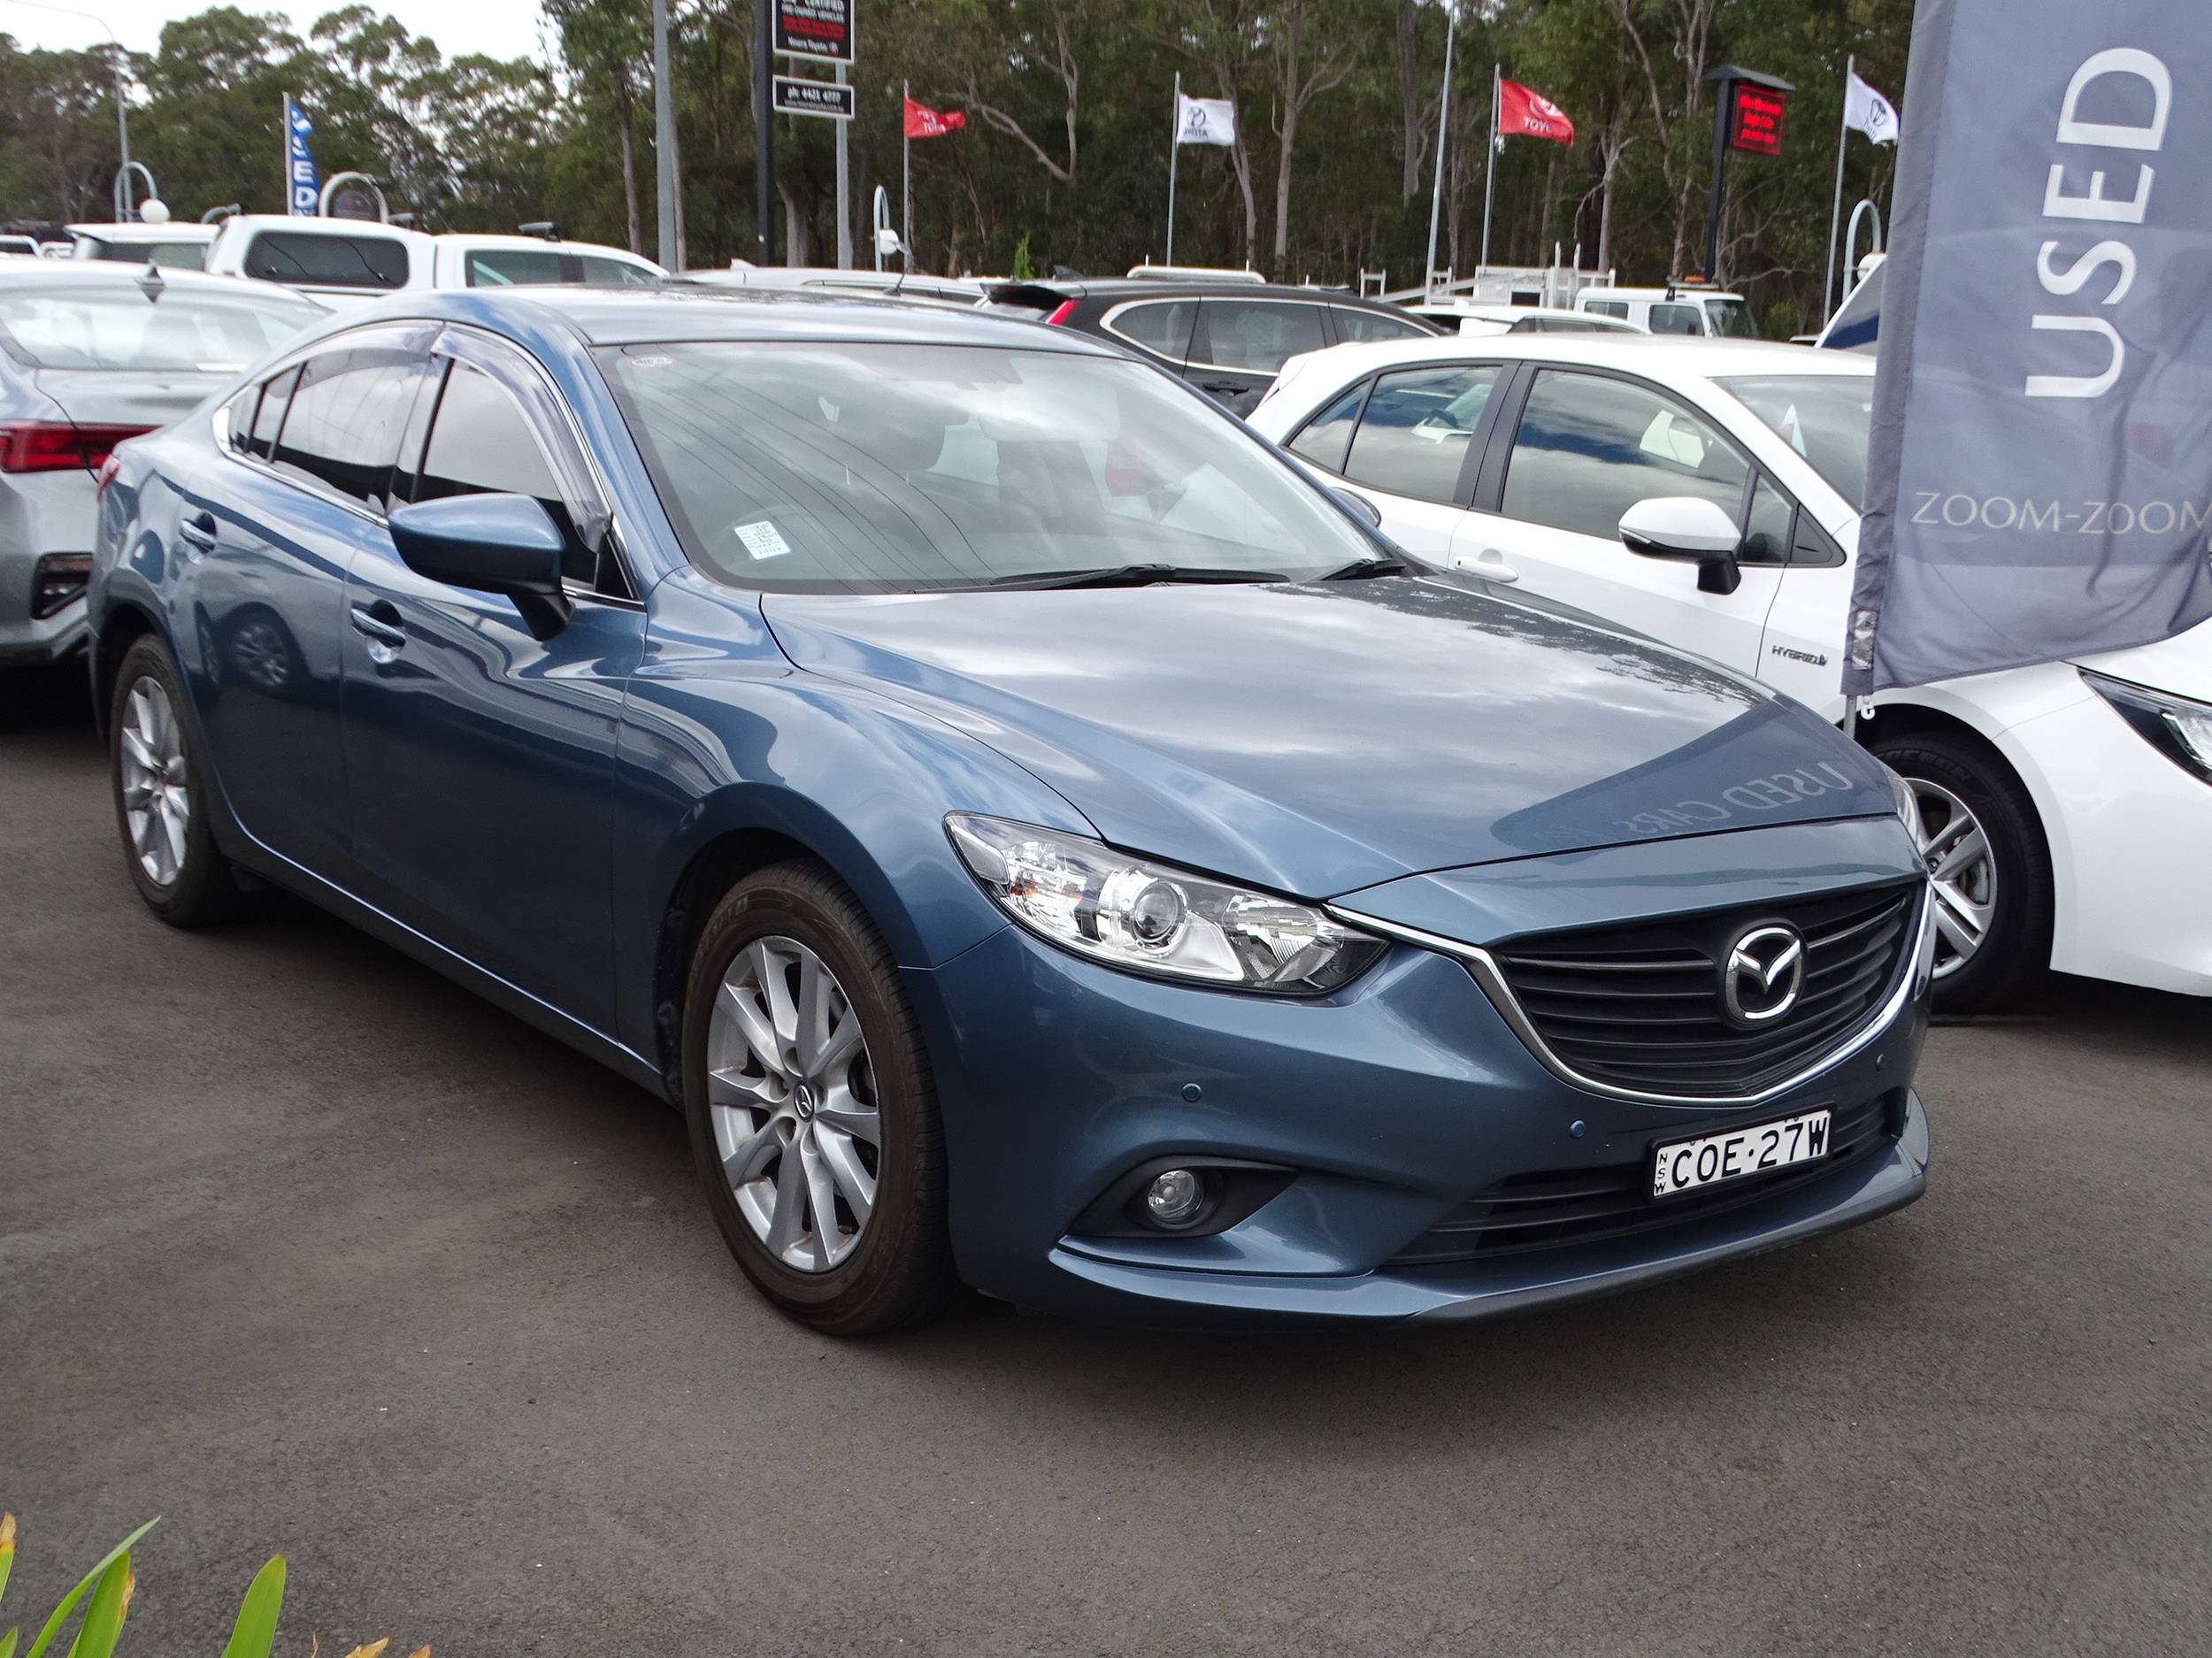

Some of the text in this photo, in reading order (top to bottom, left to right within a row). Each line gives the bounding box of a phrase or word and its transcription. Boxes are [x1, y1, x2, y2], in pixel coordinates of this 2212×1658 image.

[2024, 47, 2172, 398] USED
[1910, 491, 2212, 534] ZOOM-ZOOM
[1771, 645, 1818, 664] HYBRID
[1655, 1153, 1668, 1194] NSW
